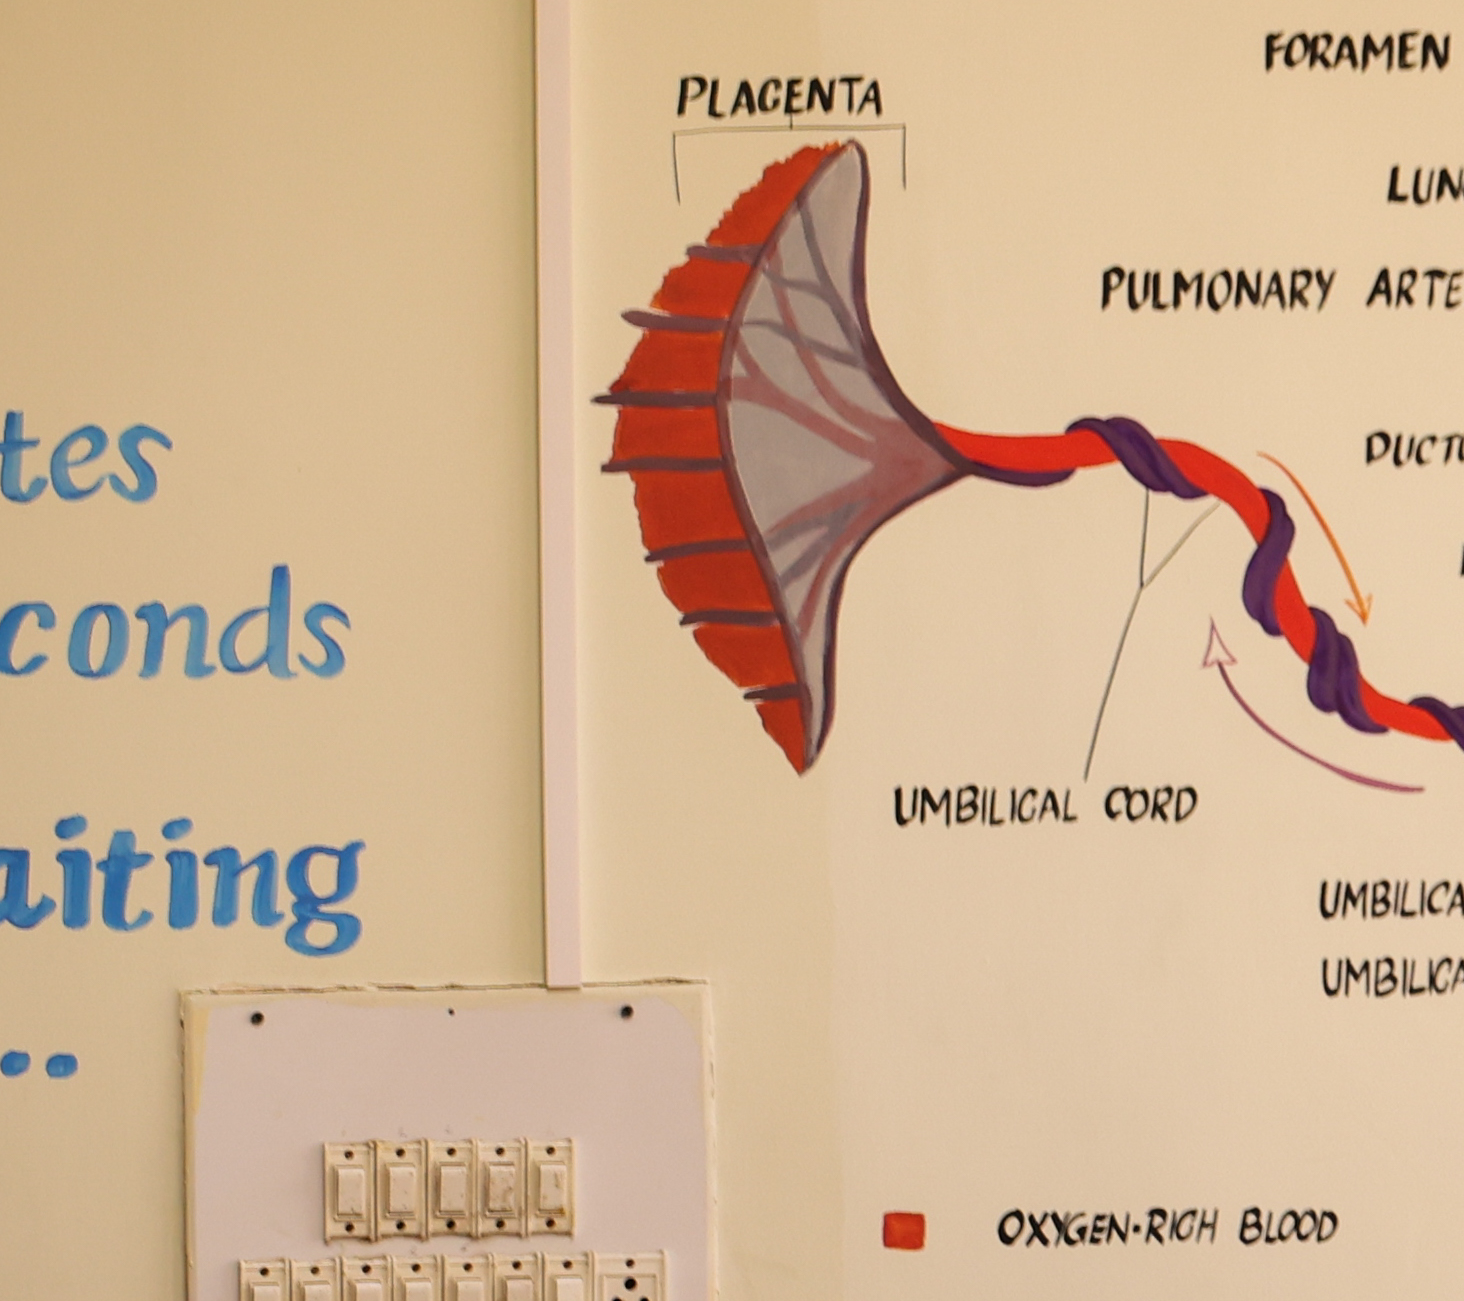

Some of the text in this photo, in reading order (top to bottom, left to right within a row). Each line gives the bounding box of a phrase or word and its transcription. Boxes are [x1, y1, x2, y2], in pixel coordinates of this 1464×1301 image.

[1264, 30, 1451, 73] FORAMEN
[676, 75, 883, 119] PLACENTA
[1101, 265, 1336, 313] PULMONARY
[894, 784, 1198, 828] UMBILICAL CORD
[1238, 1206, 1339, 1246] BLOOD
